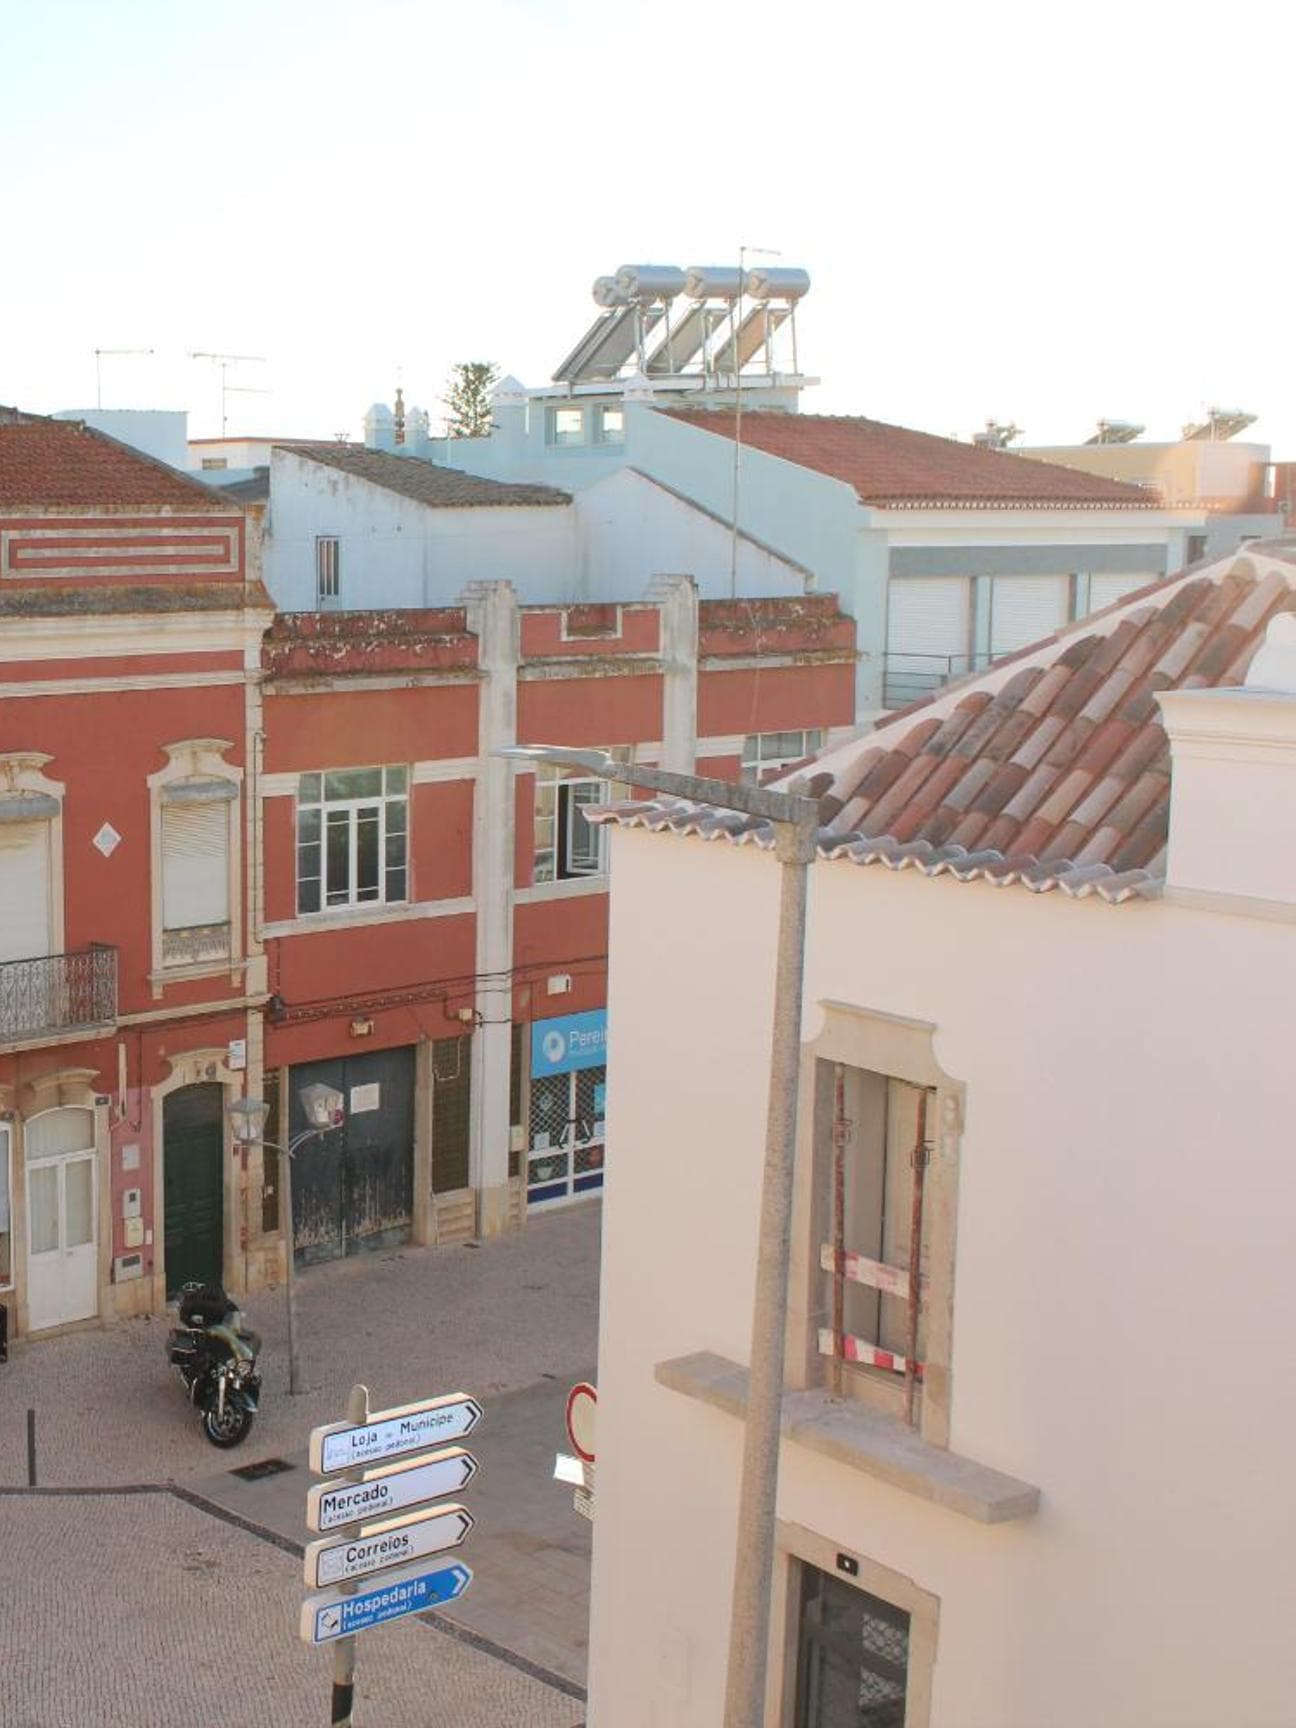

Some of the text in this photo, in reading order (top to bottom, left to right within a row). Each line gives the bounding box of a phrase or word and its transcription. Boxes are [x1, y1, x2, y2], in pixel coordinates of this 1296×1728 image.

[352, 1431, 378, 1448] Loja
[323, 1483, 389, 1514] Mercado
[345, 1534, 410, 1563] Correios
[343, 1580, 427, 1618] Hospedaria
